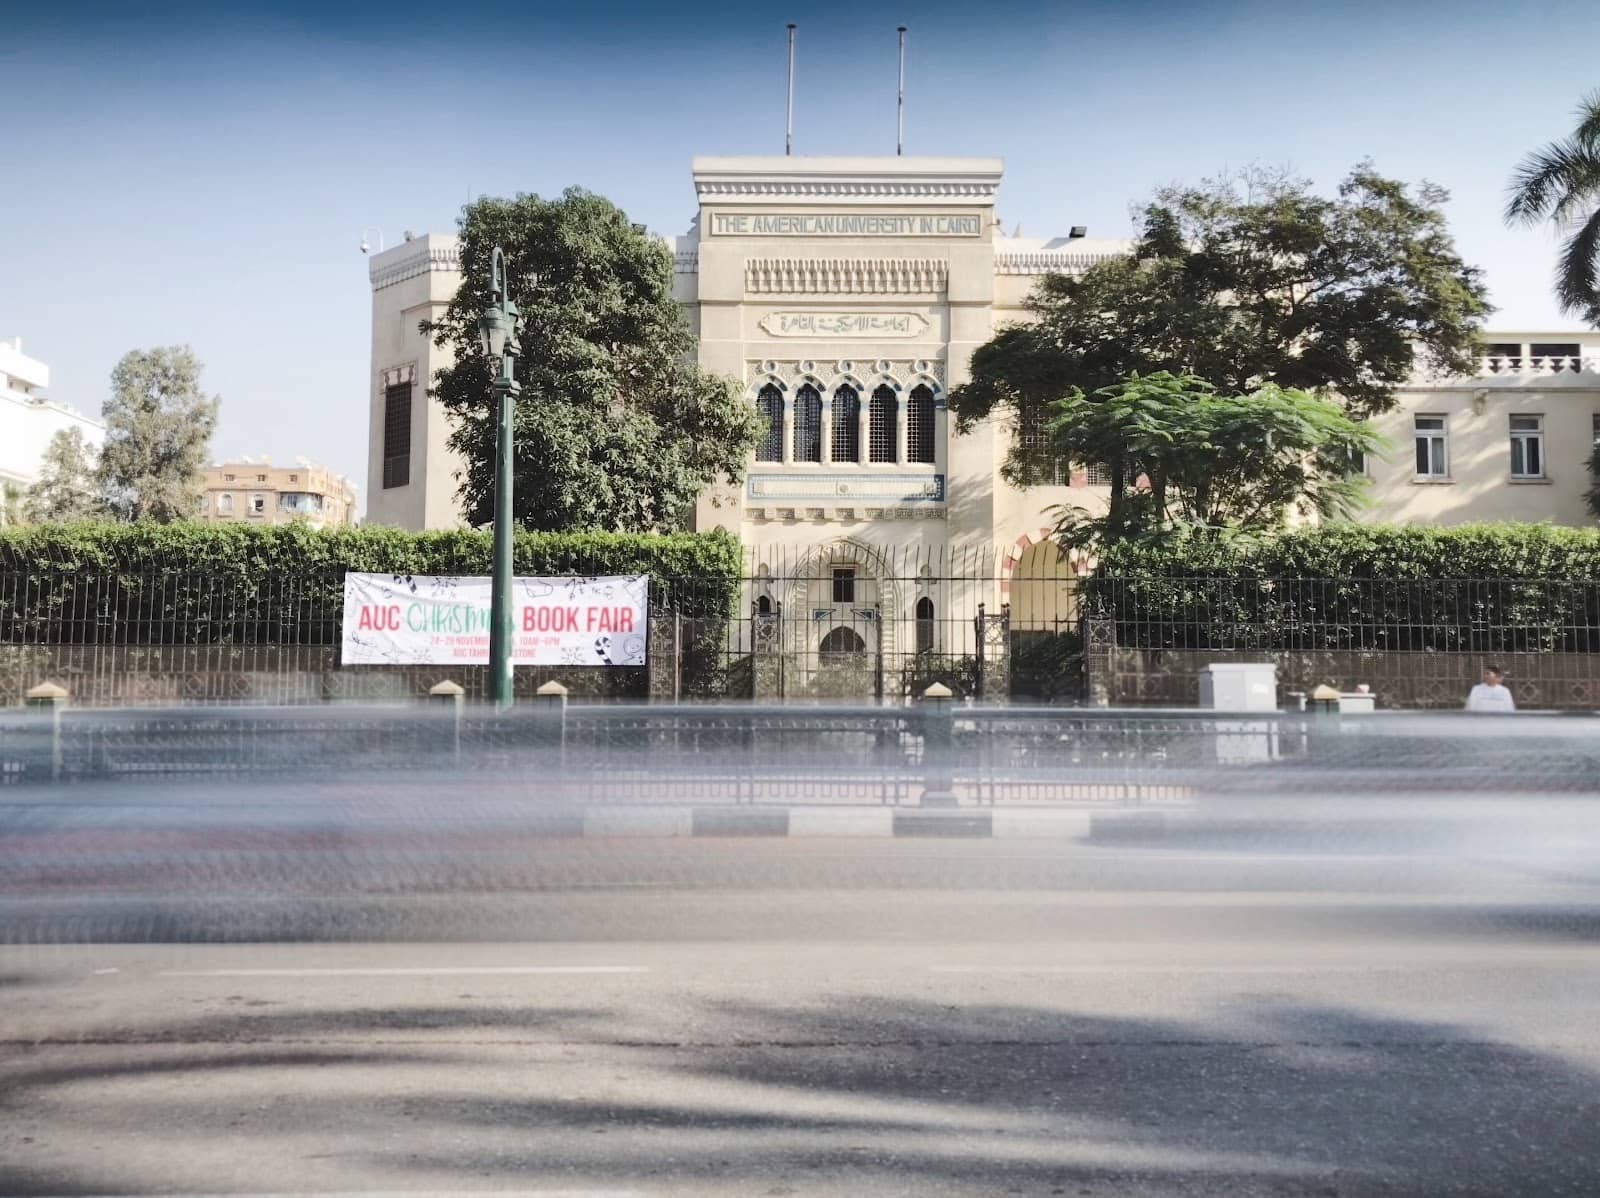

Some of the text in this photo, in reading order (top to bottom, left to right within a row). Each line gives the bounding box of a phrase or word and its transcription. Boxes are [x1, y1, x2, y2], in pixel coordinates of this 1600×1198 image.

[714, 216, 978, 234] THE AMERICAN UNIVERSITY IN CAIRO
[359, 604, 400, 631] AUC
[522, 606, 580, 632] BOOK
[586, 607, 634, 633] FAIR
